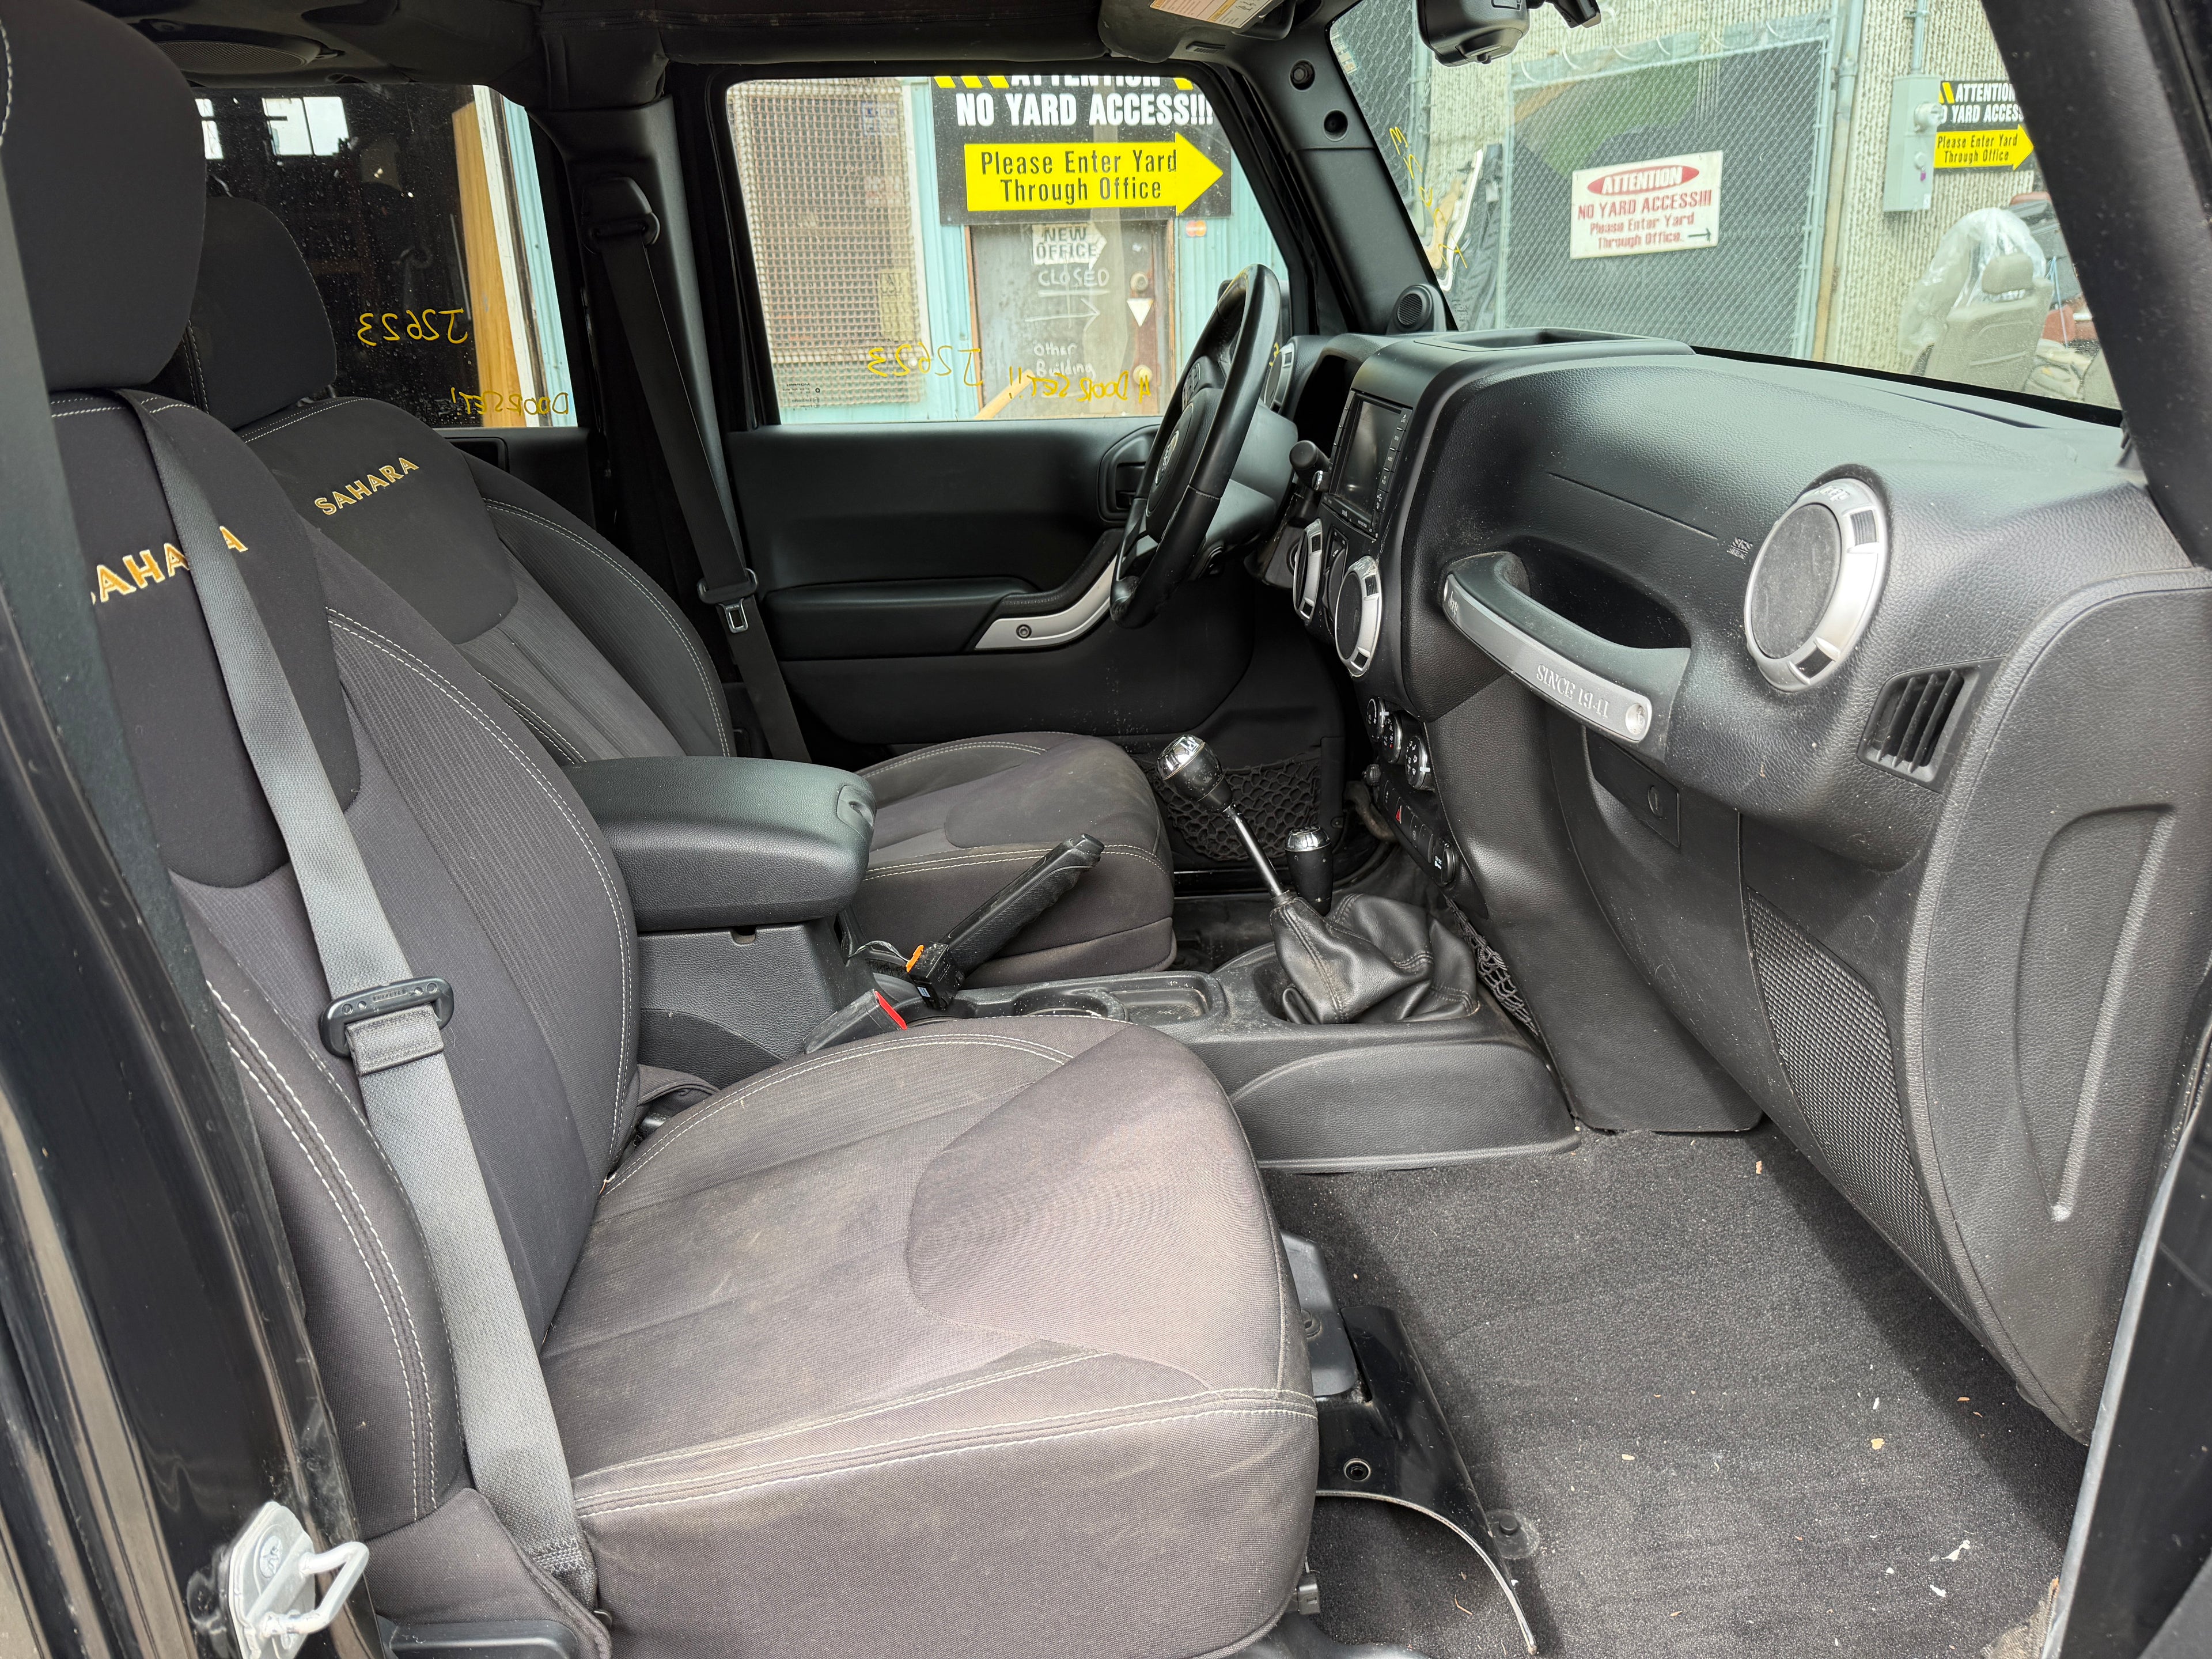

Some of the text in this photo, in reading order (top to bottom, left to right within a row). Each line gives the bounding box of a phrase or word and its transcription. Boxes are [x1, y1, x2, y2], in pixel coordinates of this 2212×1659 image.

[1955, 83, 2016, 103] ATTENTION
[956, 92, 1214, 126] NO YARD ACCESS!!!
[1952, 104, 1980, 123] YARD
[1937, 133, 2018, 149] Please Enter Yard
[980, 149, 1177, 175] Please Enter Yard
[1944, 149, 2009, 164] Through Office
[1000, 177, 1161, 205] Through Office
[1601, 166, 1683, 195] ATTENTION
[1578, 204, 1594, 220] NO
[1599, 199, 1637, 218] YARD
[1044, 225, 1087, 241] NEW
[1590, 211, 1695, 235] Please Enter Yard
[1037, 242, 1098, 259] OFFICE
[1598, 236, 1642, 249] Through
[1037, 267, 1110, 287] CLOSED
[315, 457, 419, 515] SAHARA
[90, 525, 249, 605] AHAA
[1536, 664, 1609, 719] SINCE 1941
